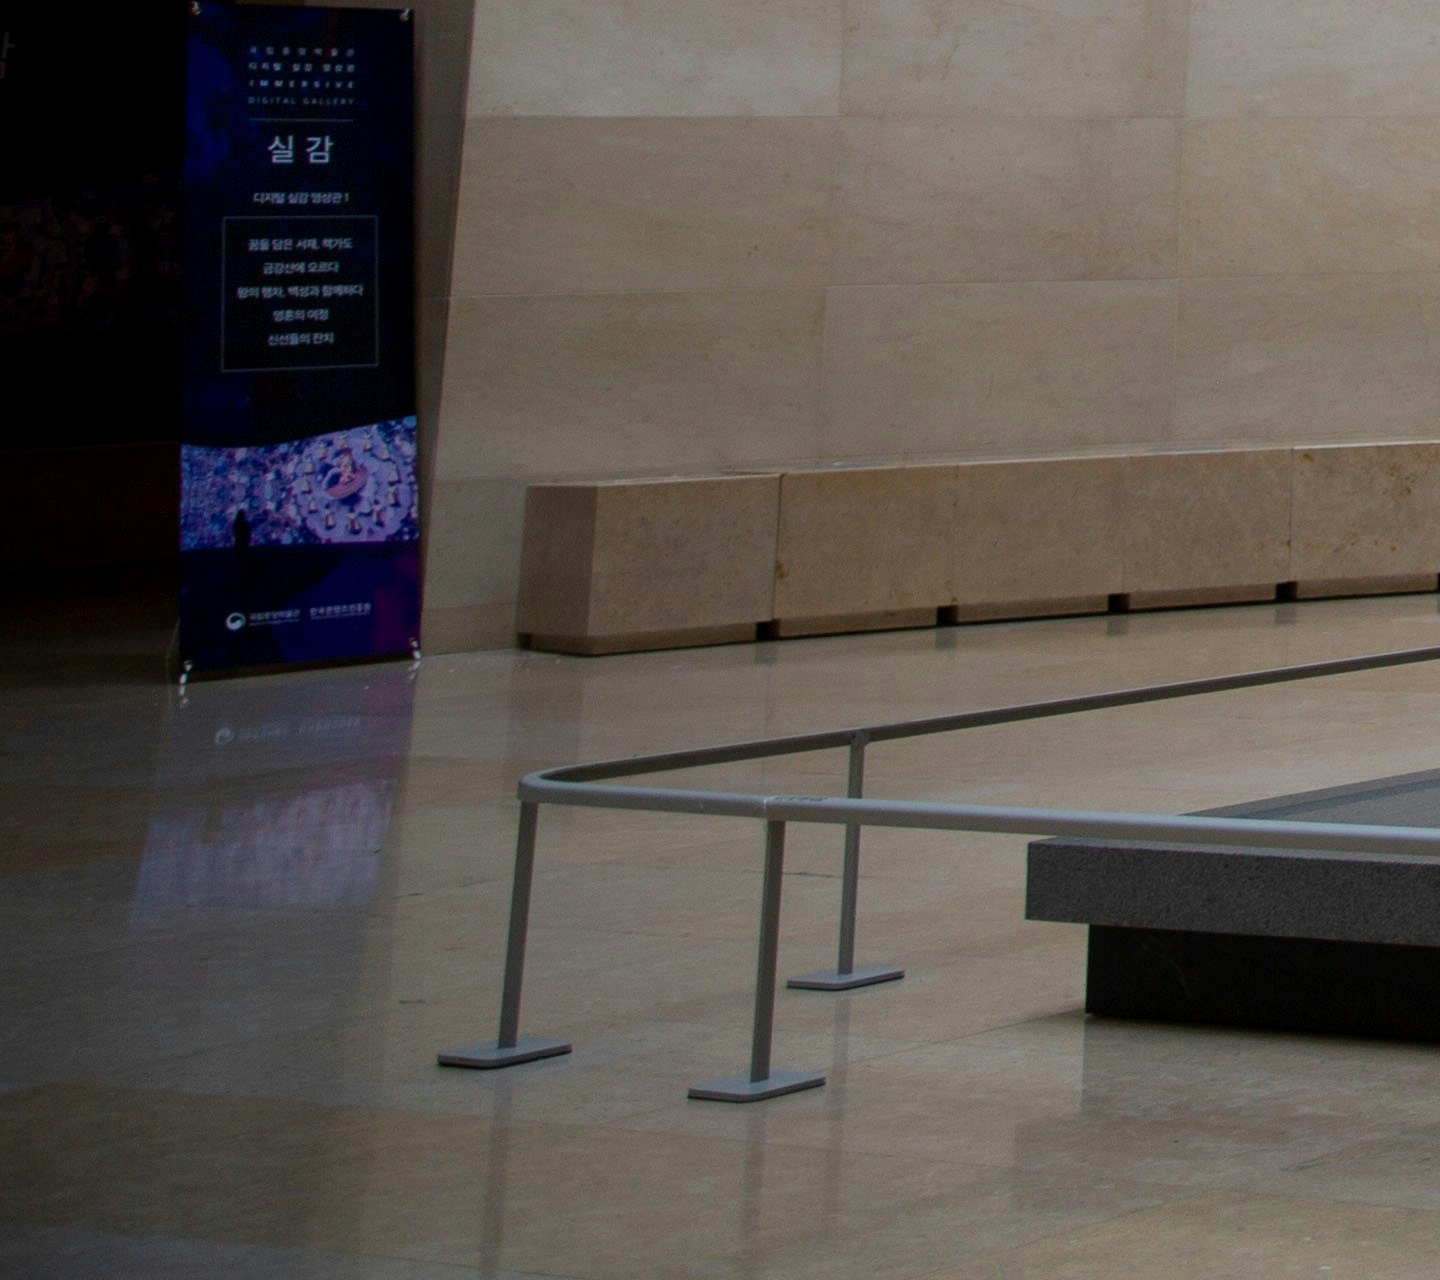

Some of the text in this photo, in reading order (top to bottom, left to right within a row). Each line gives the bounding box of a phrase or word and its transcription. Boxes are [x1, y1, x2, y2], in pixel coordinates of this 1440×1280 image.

[248, 97, 355, 106] DIGITAL GALLERY
[253, 192, 286, 204] 디지털
[287, 192, 308, 204] 실감
[263, 262, 339, 275] 금강산에 오르다
[268, 332, 334, 346] 신선들의 잔치
